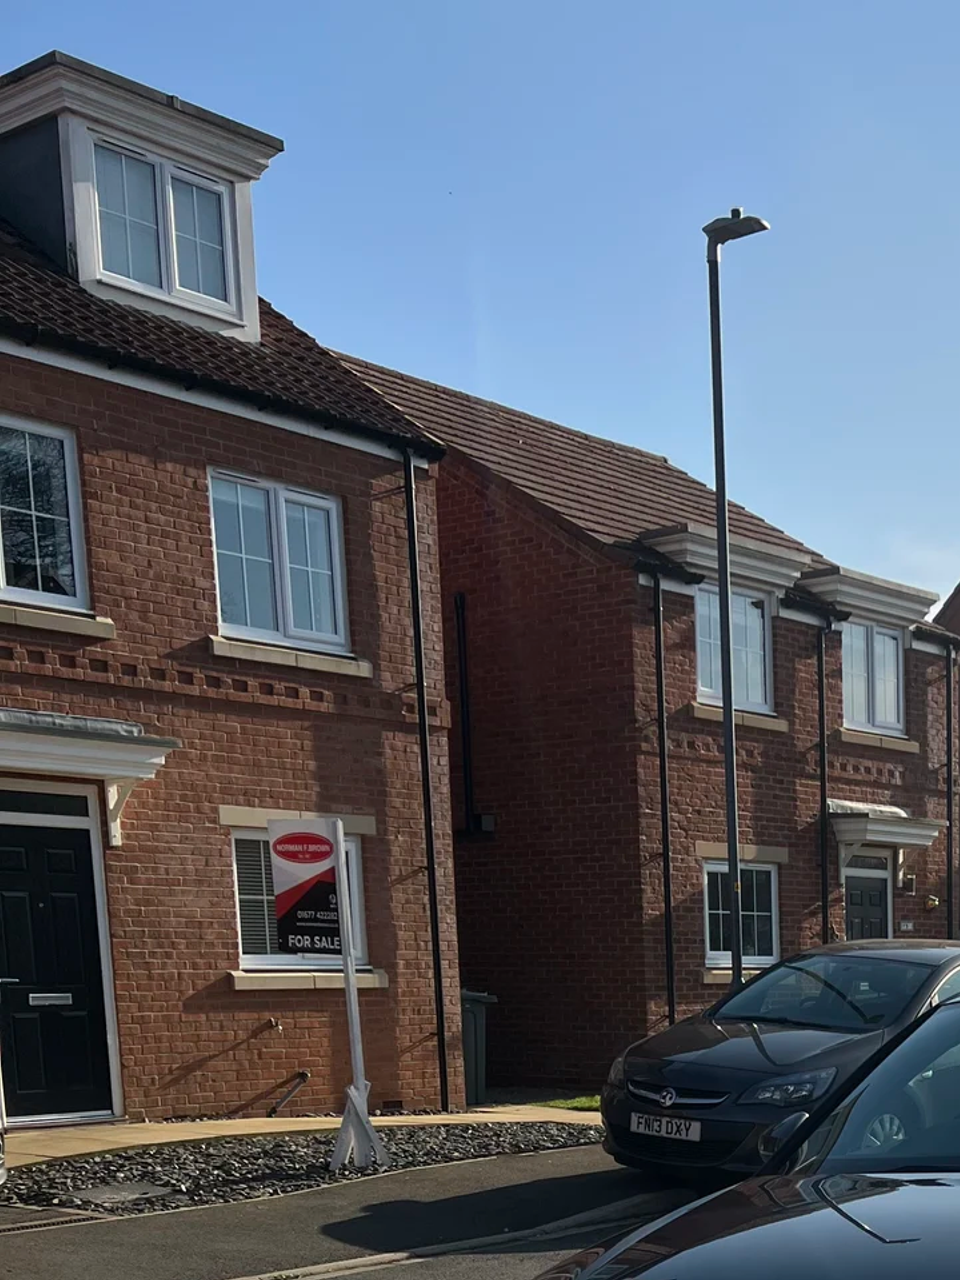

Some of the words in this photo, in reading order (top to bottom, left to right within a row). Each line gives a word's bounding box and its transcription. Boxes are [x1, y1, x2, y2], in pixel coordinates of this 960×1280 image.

[288, 934, 311, 948] FOR
[313, 935, 341, 949] SALE
[636, 1115, 662, 1134] FN13
[665, 1119, 692, 1138] DXY
